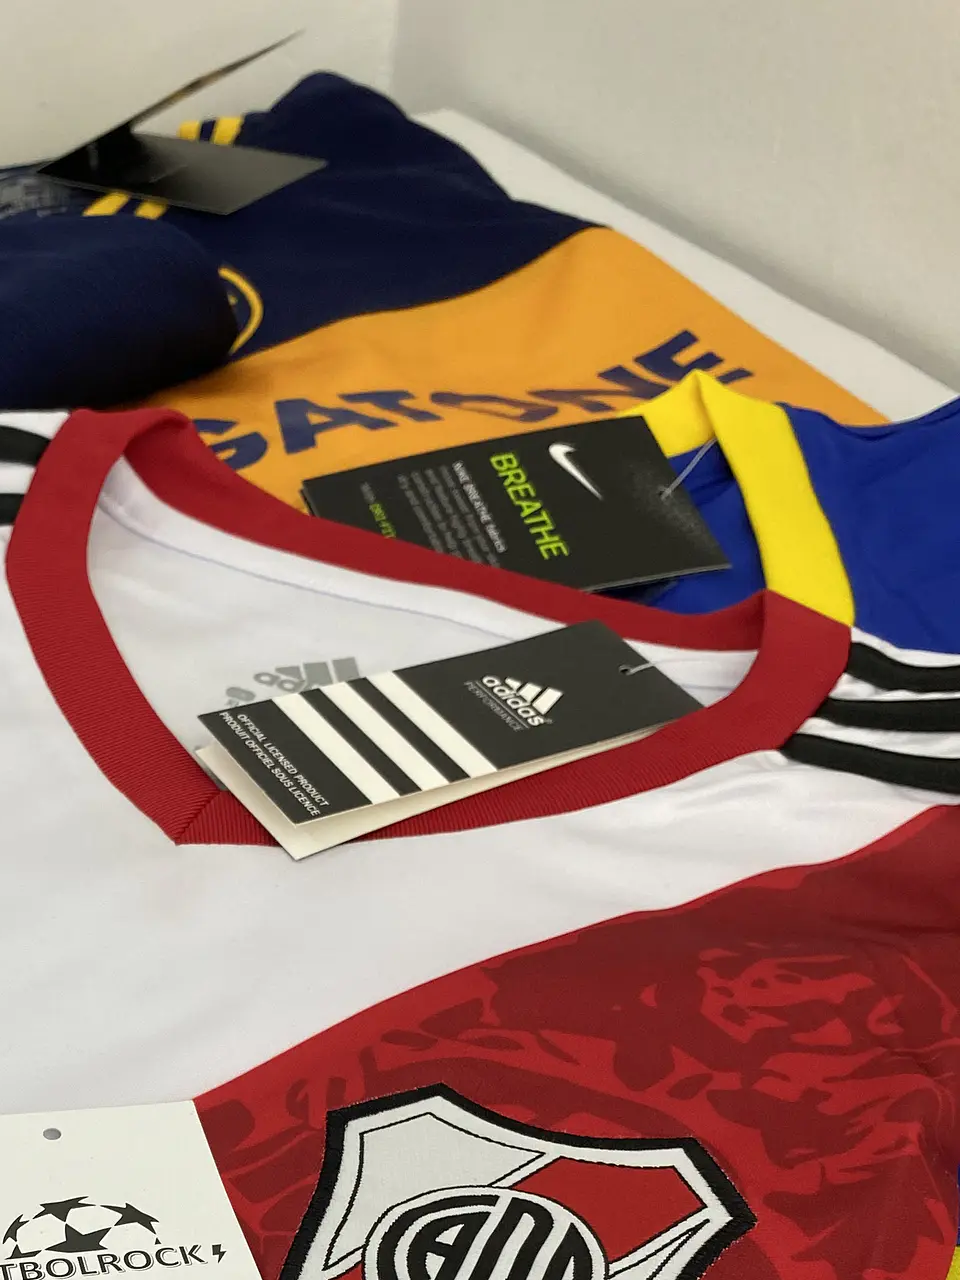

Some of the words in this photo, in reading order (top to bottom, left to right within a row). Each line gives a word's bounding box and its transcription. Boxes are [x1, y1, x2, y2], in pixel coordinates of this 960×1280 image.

[490, 453, 569, 560] BREATHE
[482, 676, 546, 727] adidas
[219, 712, 249, 741] PRODUIT
[244, 739, 275, 770] OFFICIEL
[271, 767, 294, 788] SOUS
[288, 786, 321, 817] LICENCE
[237, 713, 267, 743] OFFICIAL
[263, 742, 297, 775] LICENSED
[294, 773, 330, 807] PRODUCT
